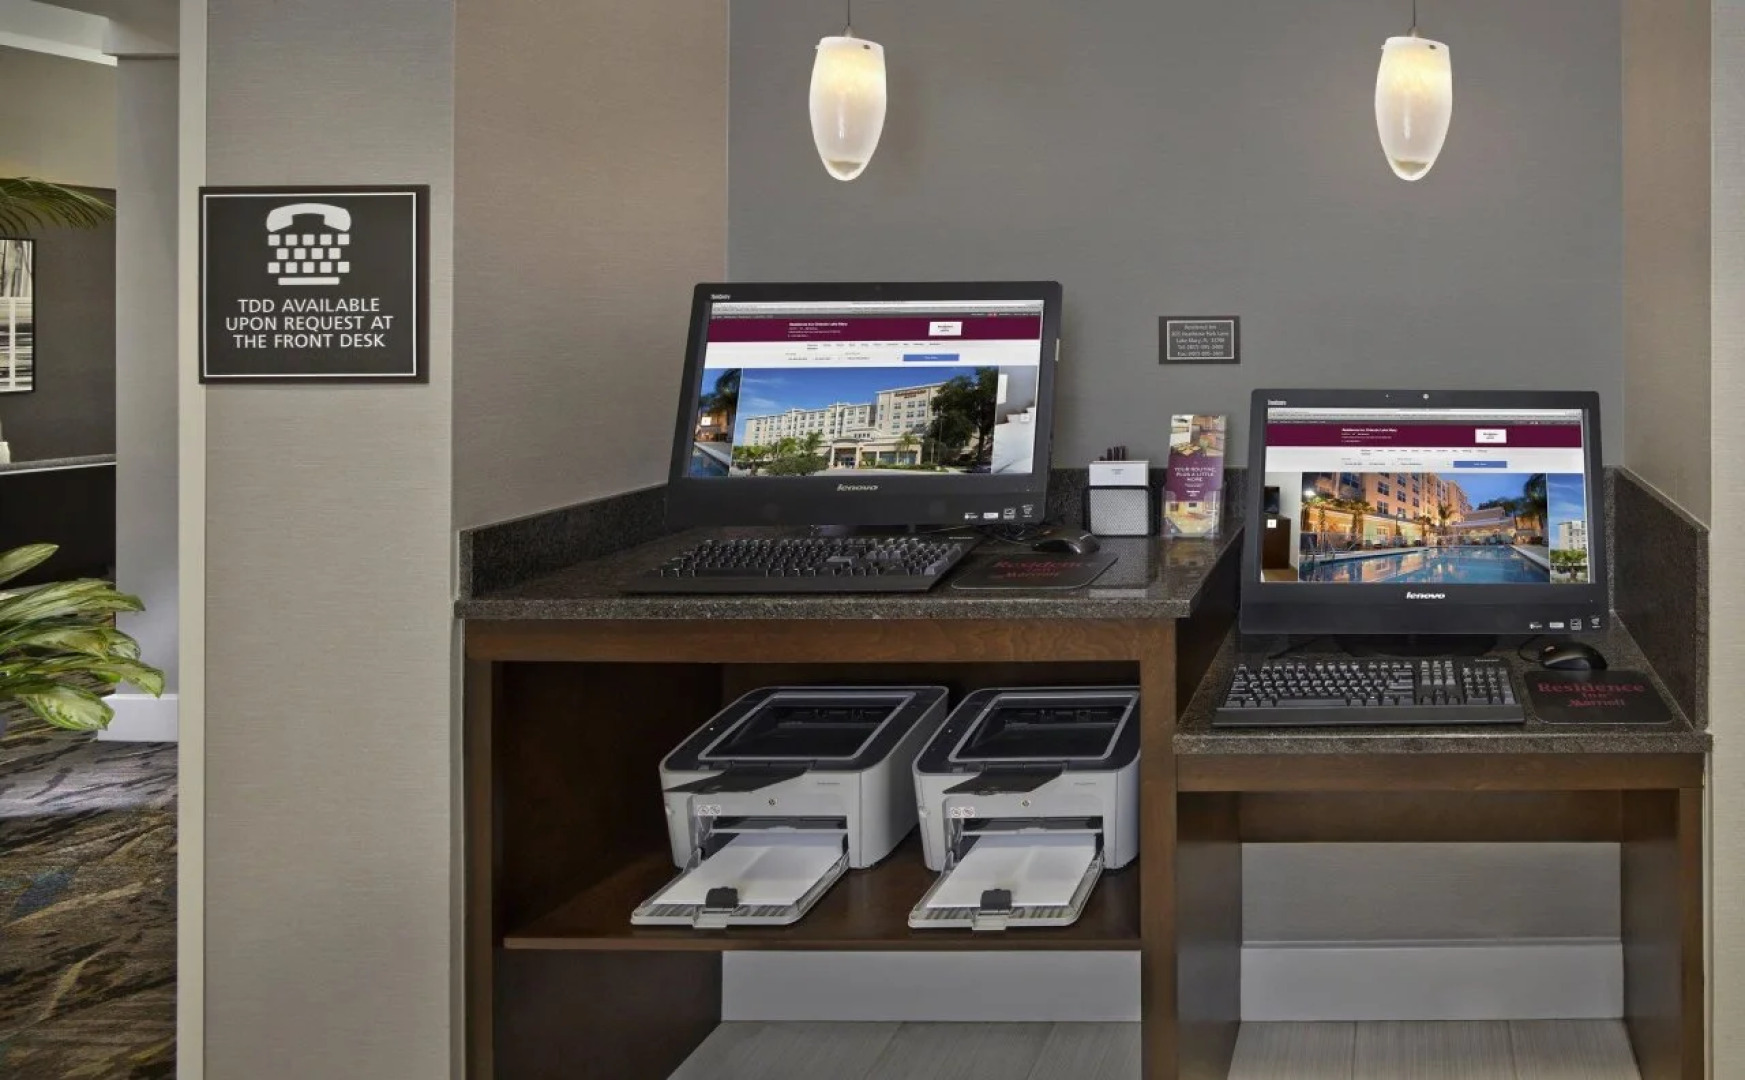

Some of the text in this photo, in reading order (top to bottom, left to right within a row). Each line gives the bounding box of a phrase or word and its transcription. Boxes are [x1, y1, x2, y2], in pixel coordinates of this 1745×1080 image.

[237, 298, 380, 313] TDD AVAILABLE
[225, 315, 394, 332] UPON REQUEST AT
[232, 333, 386, 348] THE FRONT DESK
[836, 483, 879, 492] lenovo
[1406, 591, 1446, 600] lenovo
[1537, 682, 1644, 692] Residence
